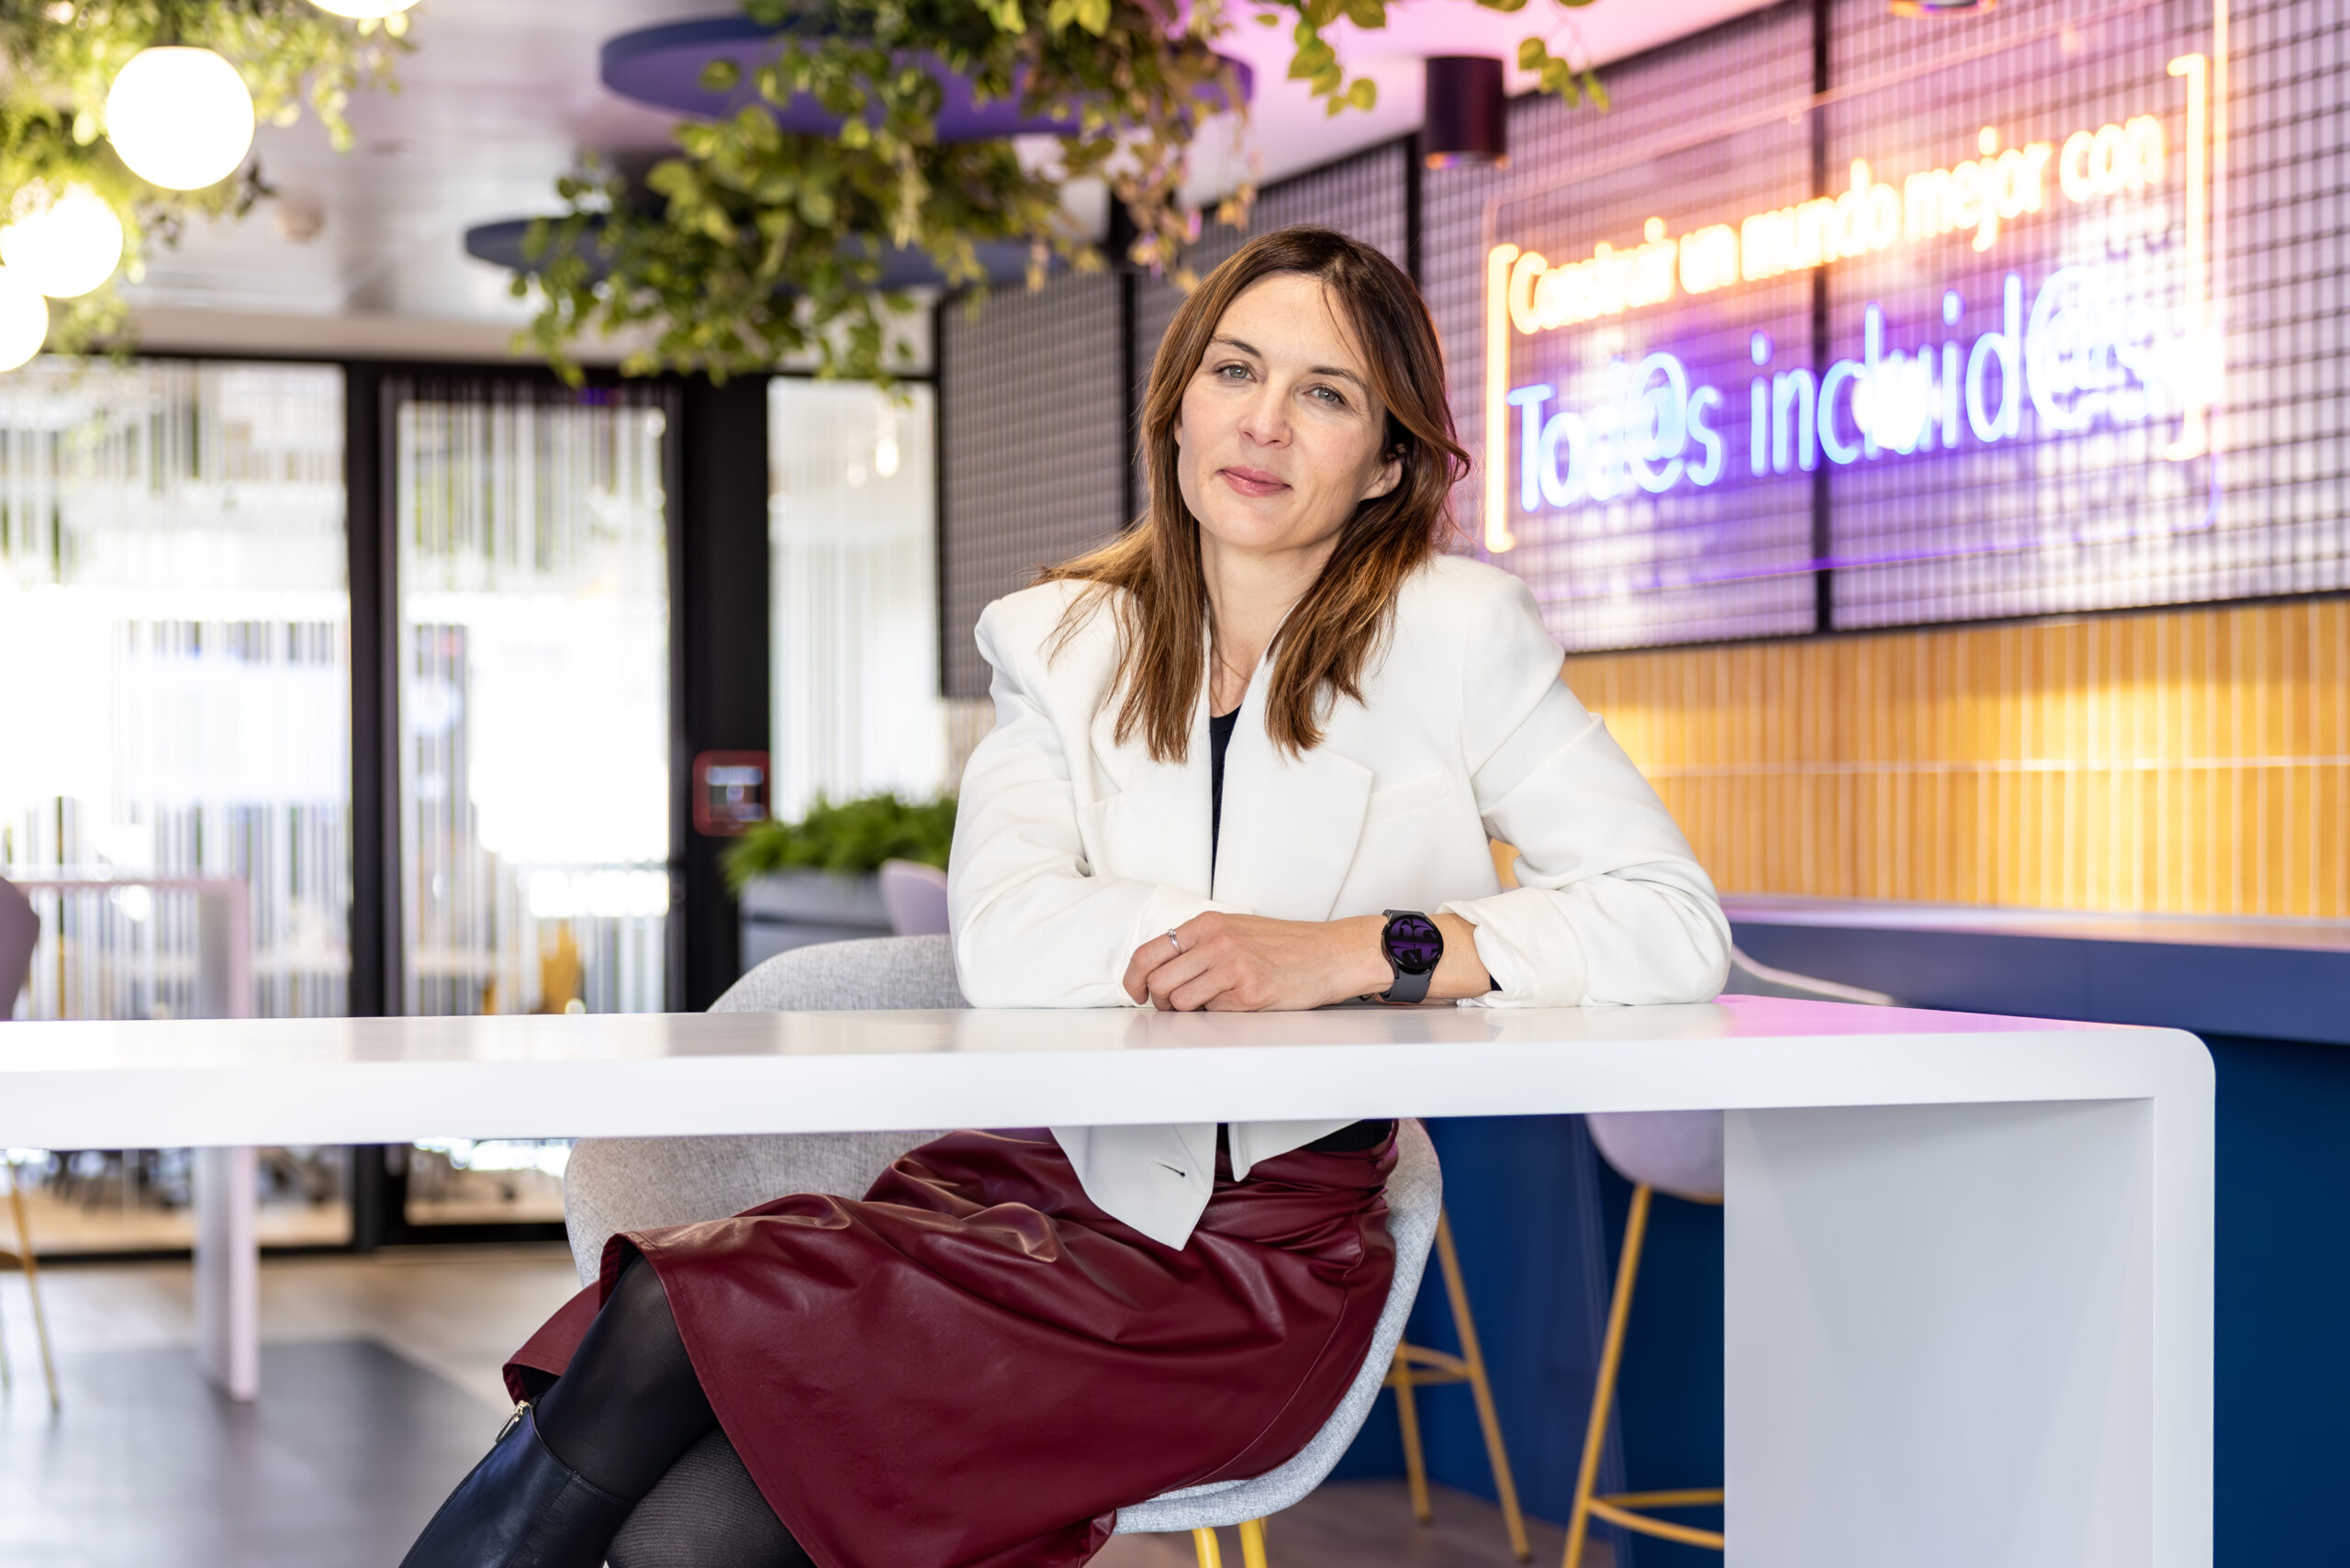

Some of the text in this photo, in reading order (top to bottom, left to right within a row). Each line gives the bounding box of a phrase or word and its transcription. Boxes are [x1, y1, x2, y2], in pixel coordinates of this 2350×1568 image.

[1679, 224, 1740, 294] un
[1741, 158, 1902, 282] mundo
[1903, 126, 2054, 252] mejor
[2059, 115, 2167, 202] con
